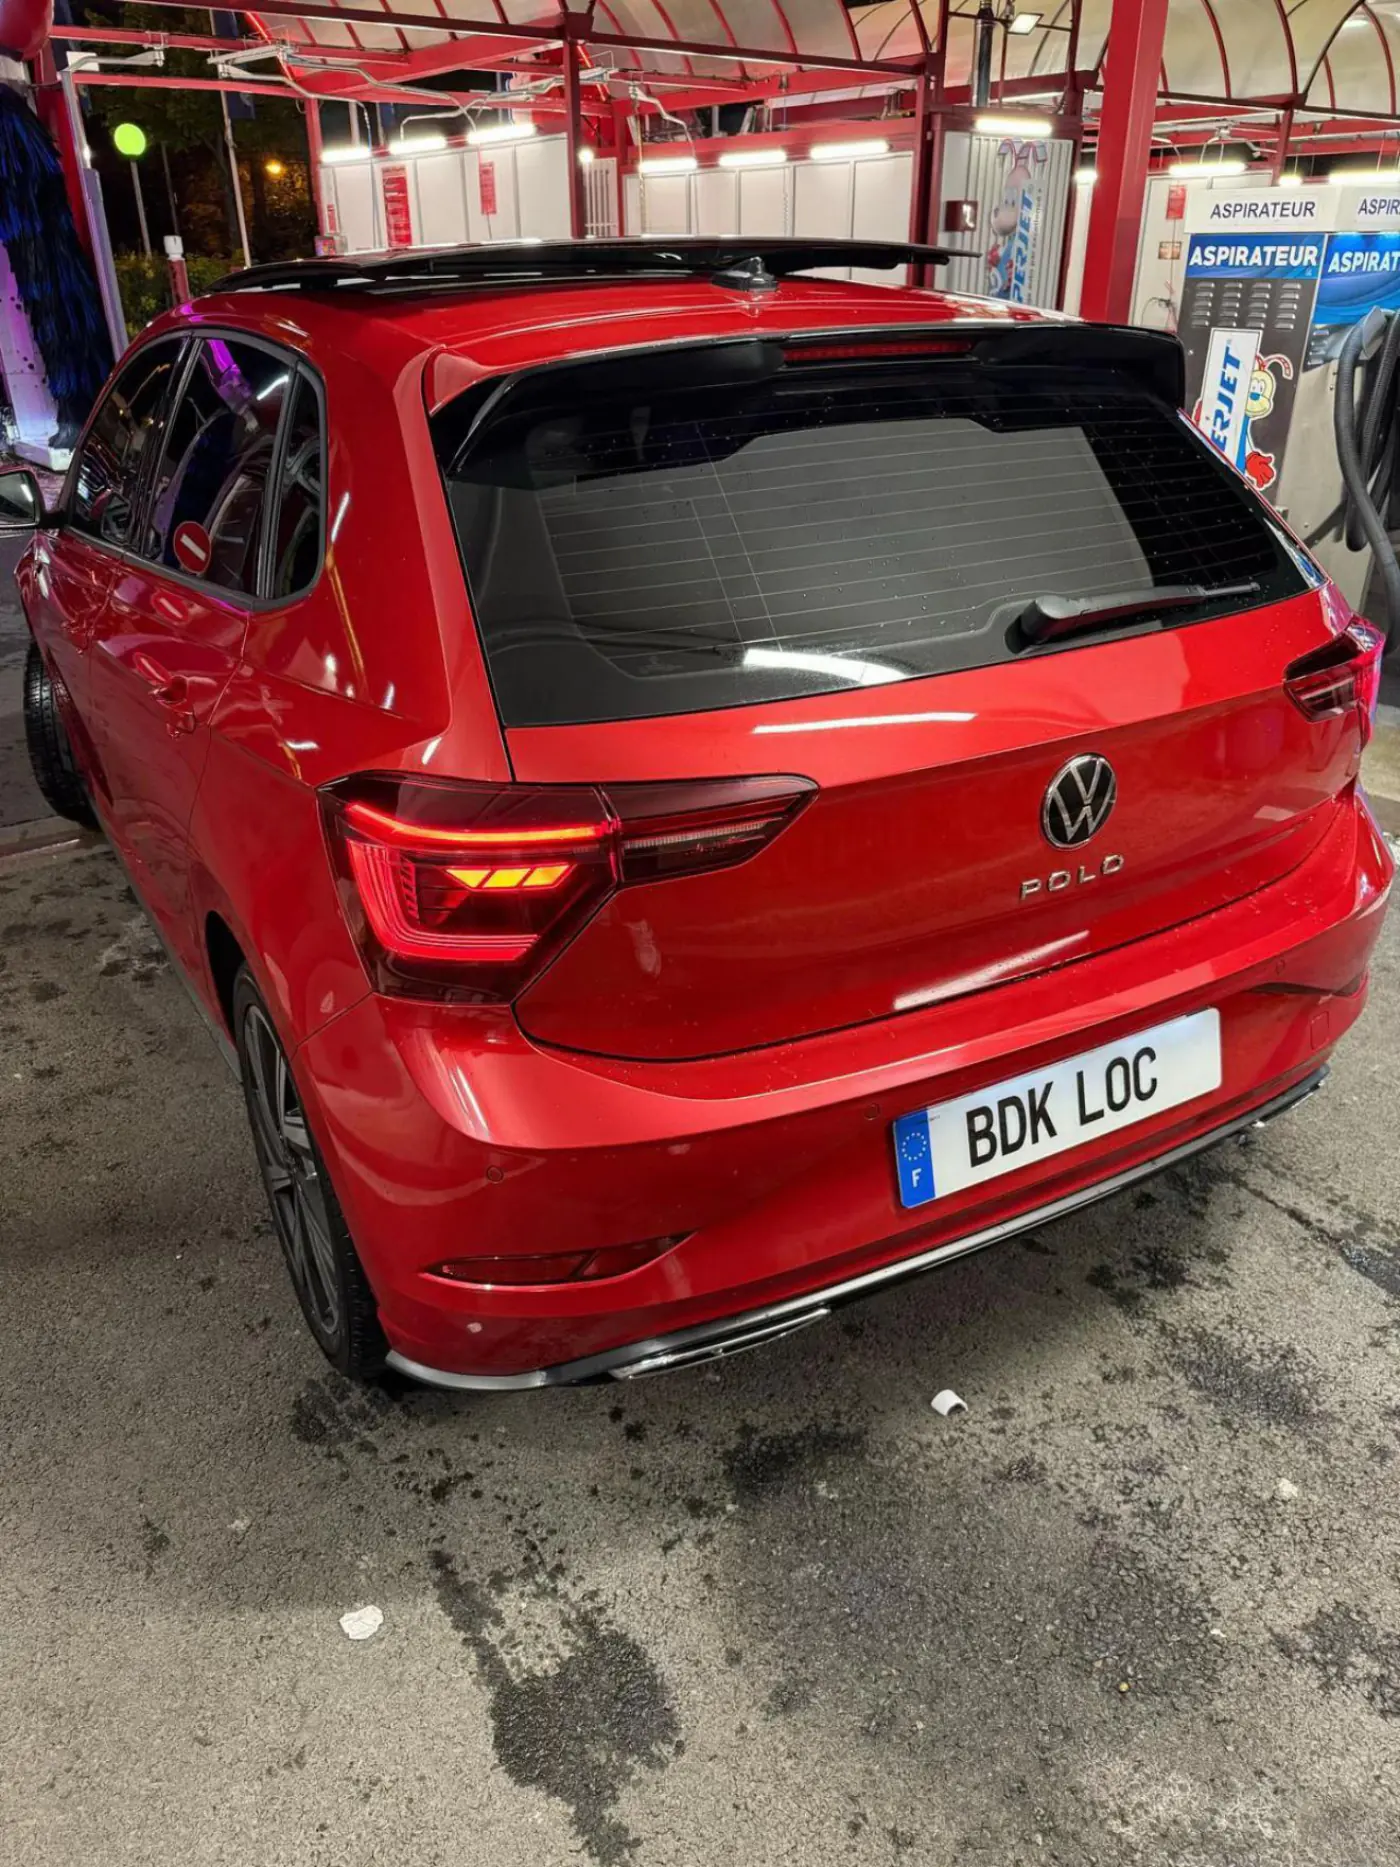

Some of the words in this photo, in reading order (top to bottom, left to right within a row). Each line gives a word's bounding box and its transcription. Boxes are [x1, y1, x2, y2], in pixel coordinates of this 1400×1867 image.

[1210, 201, 1316, 219] ASPIRATEUR
[1189, 245, 1319, 267] ASPIRATEUR
[1328, 250, 1400, 273] ASPIRAT
[1021, 854, 1124, 900] POLO
[966, 1081, 1057, 1168] BDK
[1076, 1046, 1158, 1126] LOC
[911, 1168, 922, 1188] F
